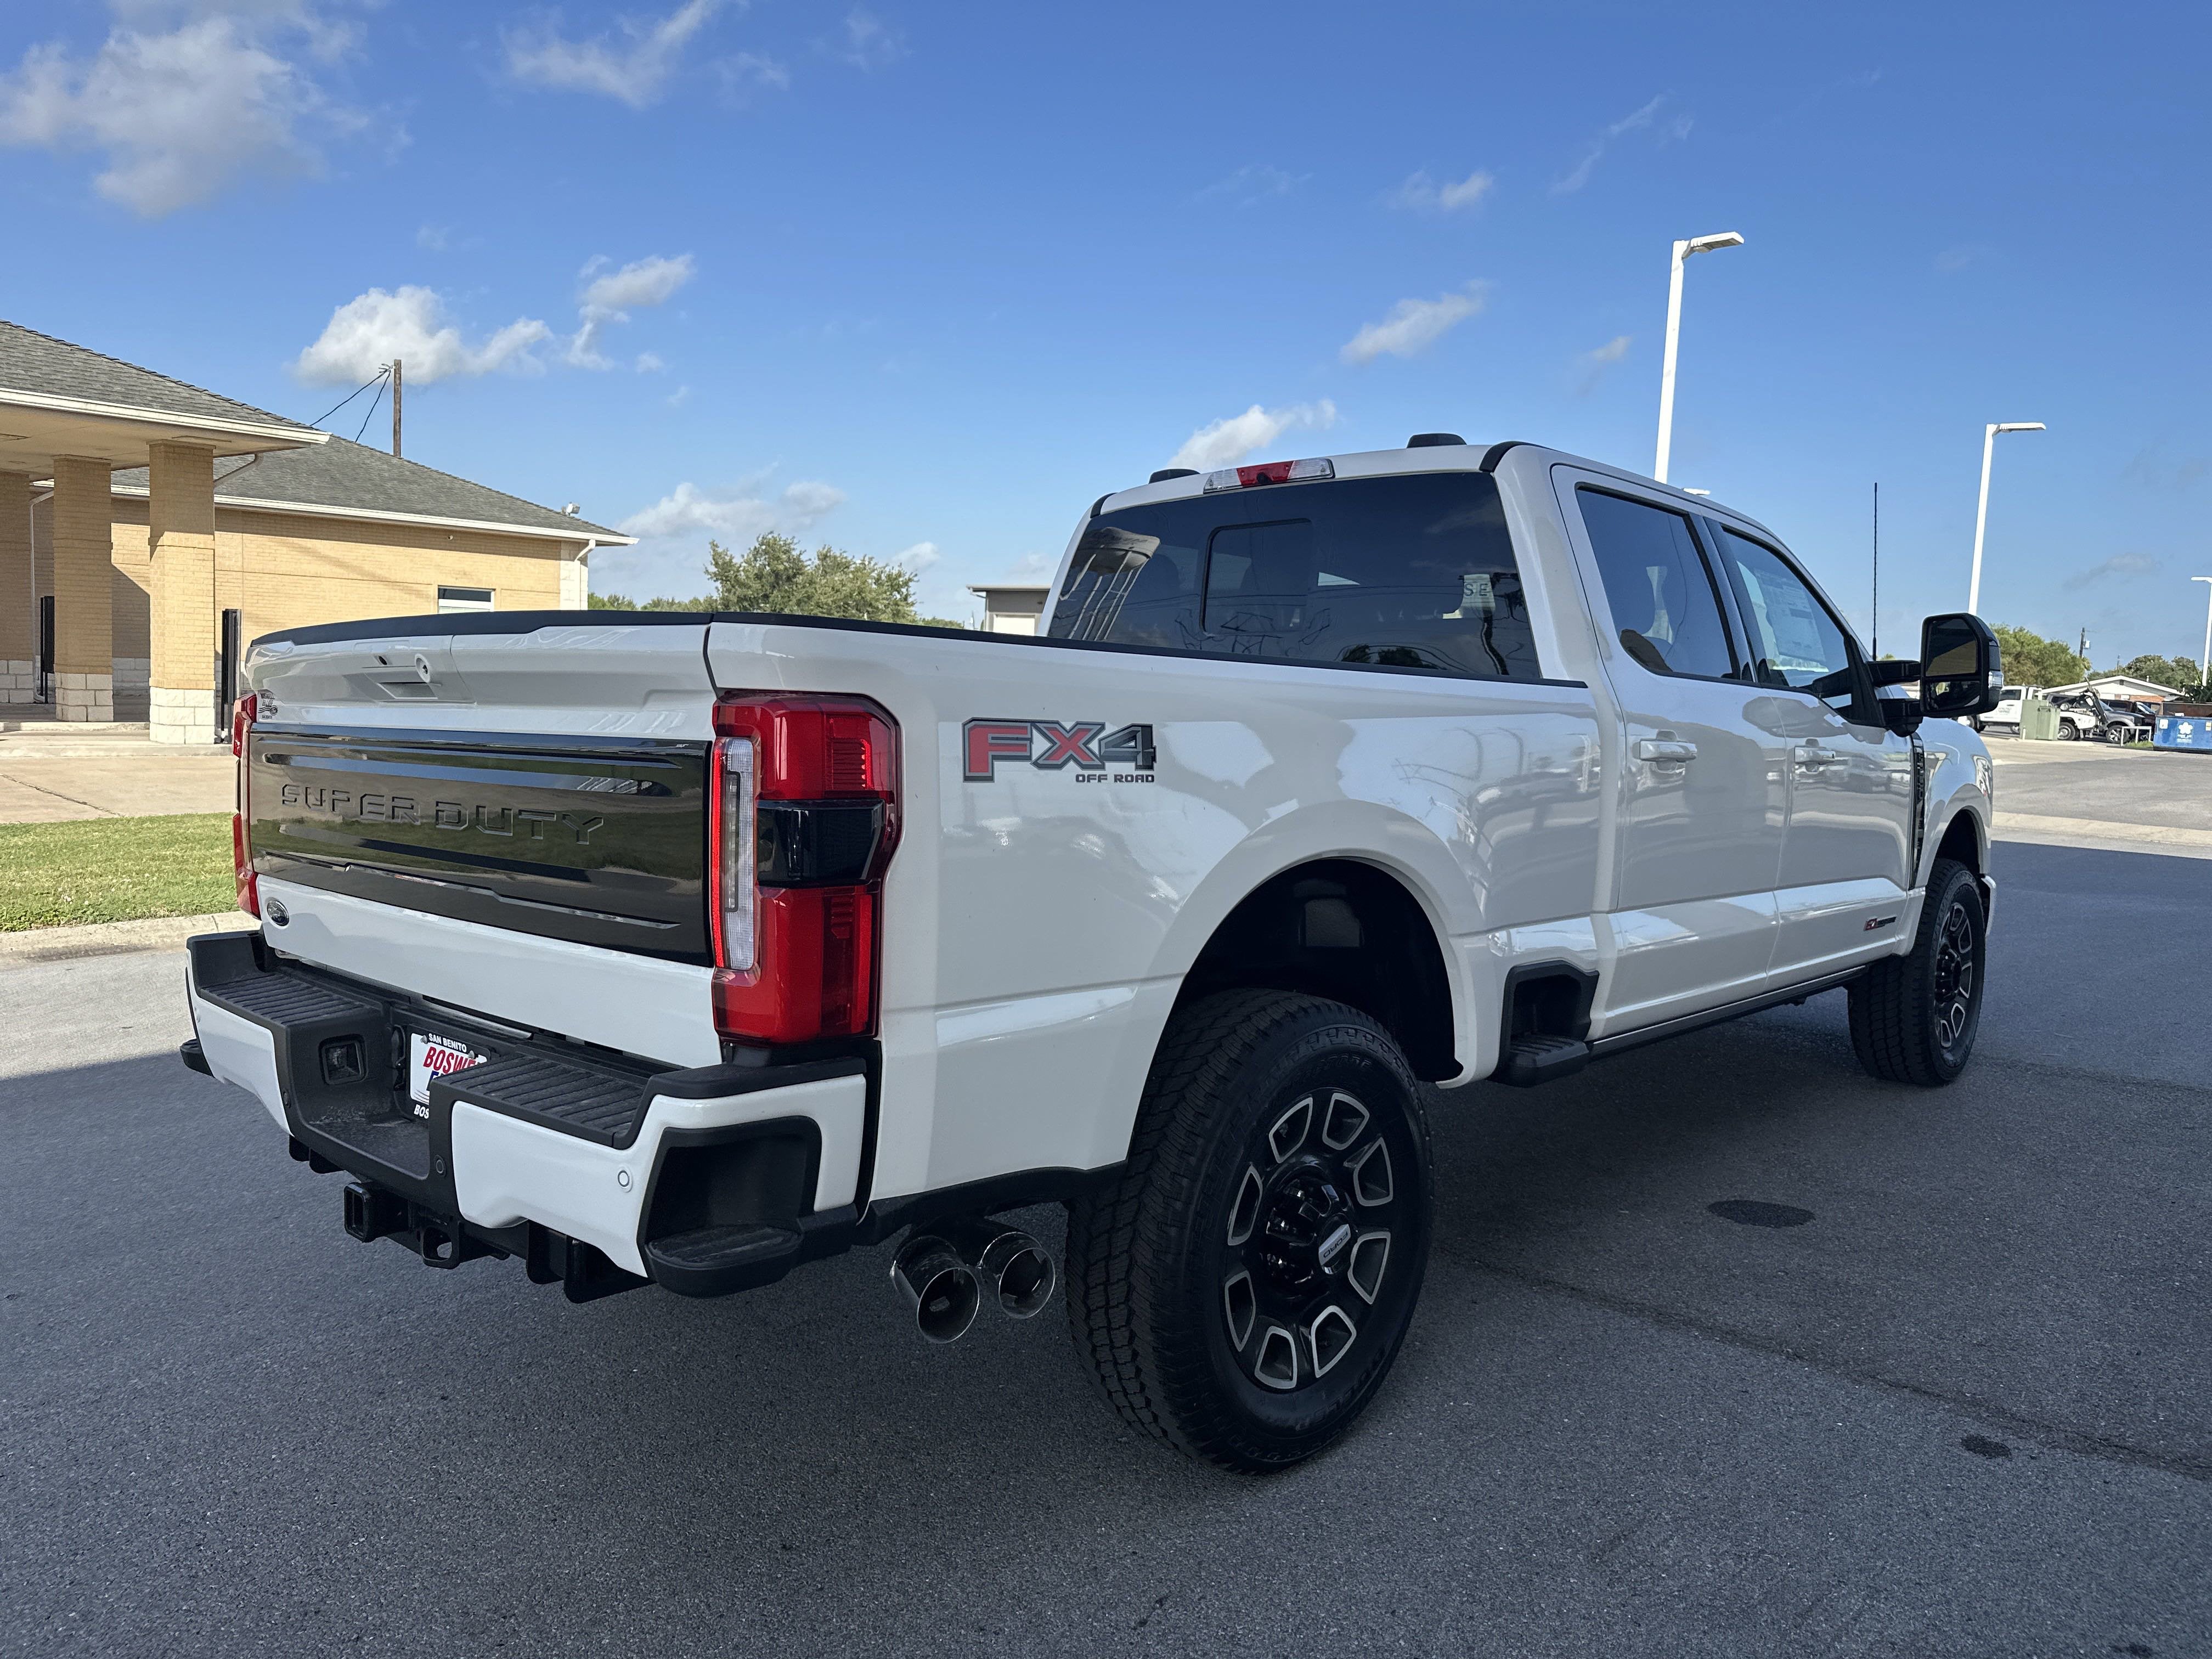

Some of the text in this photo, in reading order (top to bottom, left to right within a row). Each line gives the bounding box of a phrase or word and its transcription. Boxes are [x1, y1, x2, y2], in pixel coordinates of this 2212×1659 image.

[962, 717, 1156, 783] FX4
[1075, 774, 1155, 783] OFF ROAD
[281, 783, 605, 845] SUPER DUTY
[428, 1033, 467, 1053] SAN BENITO
